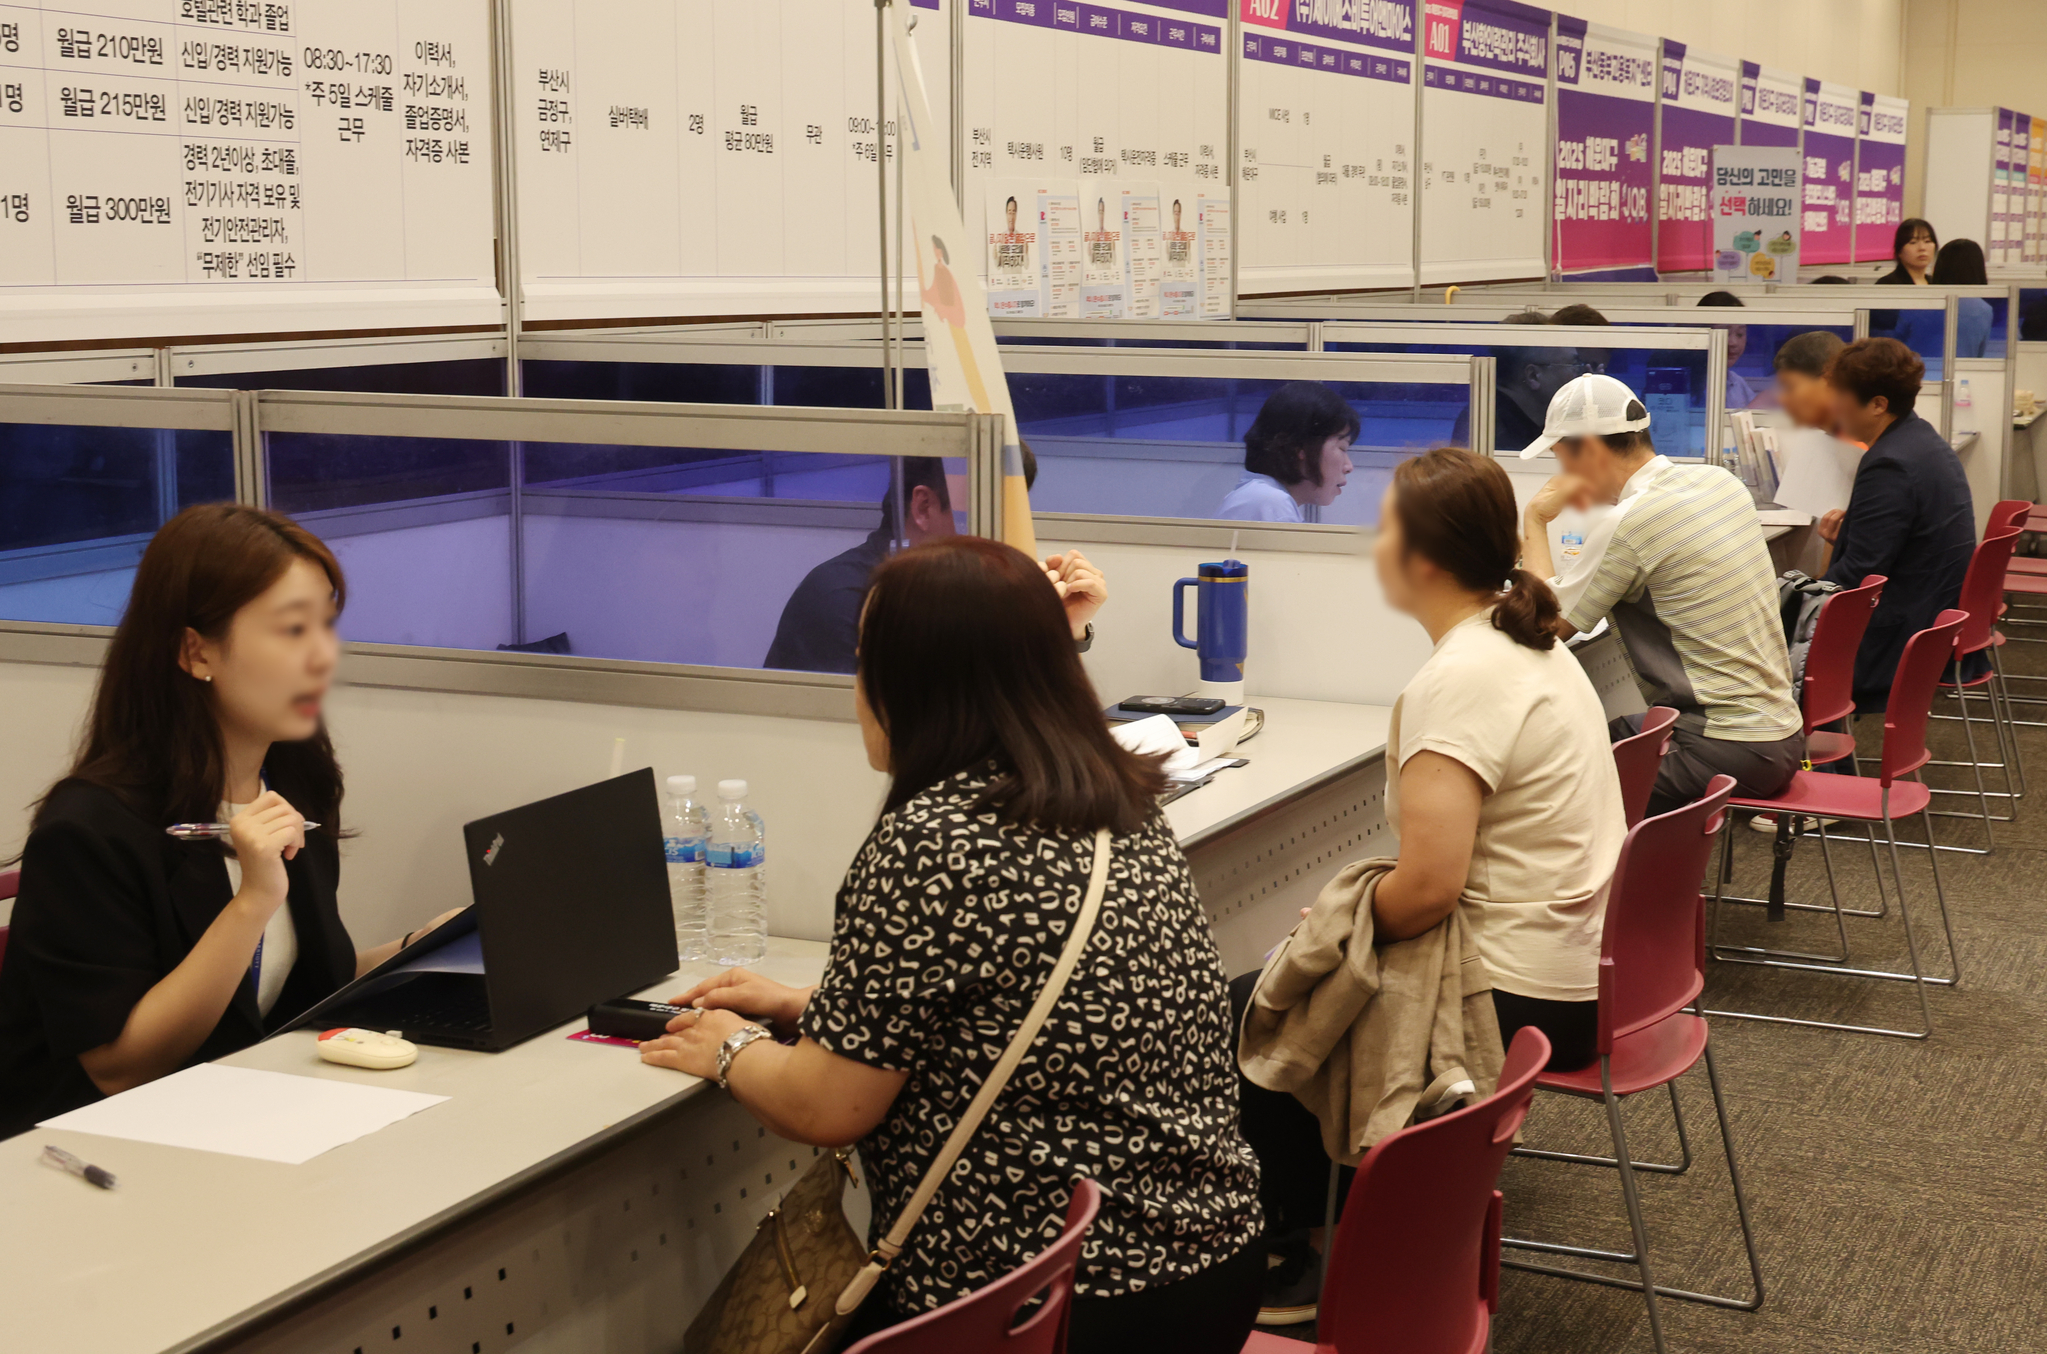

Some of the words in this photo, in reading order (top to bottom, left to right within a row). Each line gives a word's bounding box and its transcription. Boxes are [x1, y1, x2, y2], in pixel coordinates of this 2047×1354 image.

[236, 0, 262, 29] 학과
[264, 3, 290, 31] 졸업
[0, 23, 20, 53] 명
[57, 28, 93, 60] 월급
[96, 33, 164, 66] 210만원
[1429, 21, 1450, 54] A01
[181, 41, 240, 72] 신입/경력
[243, 46, 293, 77] 지원가능
[304, 47, 393, 75] 08:30~17:30
[415, 40, 457, 69] 이력서,
[403, 72, 469, 102] 자기소개서,
[538, 67, 570, 93] 부산시
[60, 86, 96, 118] 월급
[100, 92, 167, 122] 215만원
[329, 84, 352, 109] 5일
[354, 85, 394, 113] 스케줄
[538, 97, 572, 124] 금정구,
[184, 95, 242, 126] 신입/경력
[245, 100, 295, 131] 지원가능
[404, 106, 470, 133] 졸업증명서,
[608, 104, 649, 131] 실버택배
[689, 113, 705, 135] 2명
[740, 104, 758, 127] 월급
[337, 117, 365, 143] 근무
[539, 128, 572, 154] 연제구
[725, 130, 743, 152] 평균
[745, 131, 773, 154] 80만원
[806, 123, 822, 145] 무관
[183, 143, 208, 172] 경력
[211, 144, 259, 175] 2년이상,
[261, 148, 300, 176] 초대졸,
[405, 137, 444, 164] 자격증
[445, 139, 470, 164] 사본
[865, 143, 878, 162] 6일
[1559, 141, 1584, 170] 2025
[1716, 167, 1754, 187] 당신의
[1757, 168, 1797, 188] 고민을
[0, 193, 29, 223] 1명
[184, 179, 234, 208] 전기기사
[236, 181, 260, 209] 자격
[264, 182, 287, 209] 보유
[289, 182, 300, 210] 및
[1554, 178, 1620, 221] 일자리박람회
[1719, 195, 1793, 217] 선택하세요!
[66, 194, 101, 225] 월급
[105, 196, 172, 225] 300만원
[201, 216, 289, 244] 전기안전관리자,
[246, 251, 270, 278] 선임
[272, 251, 297, 279] 필수
